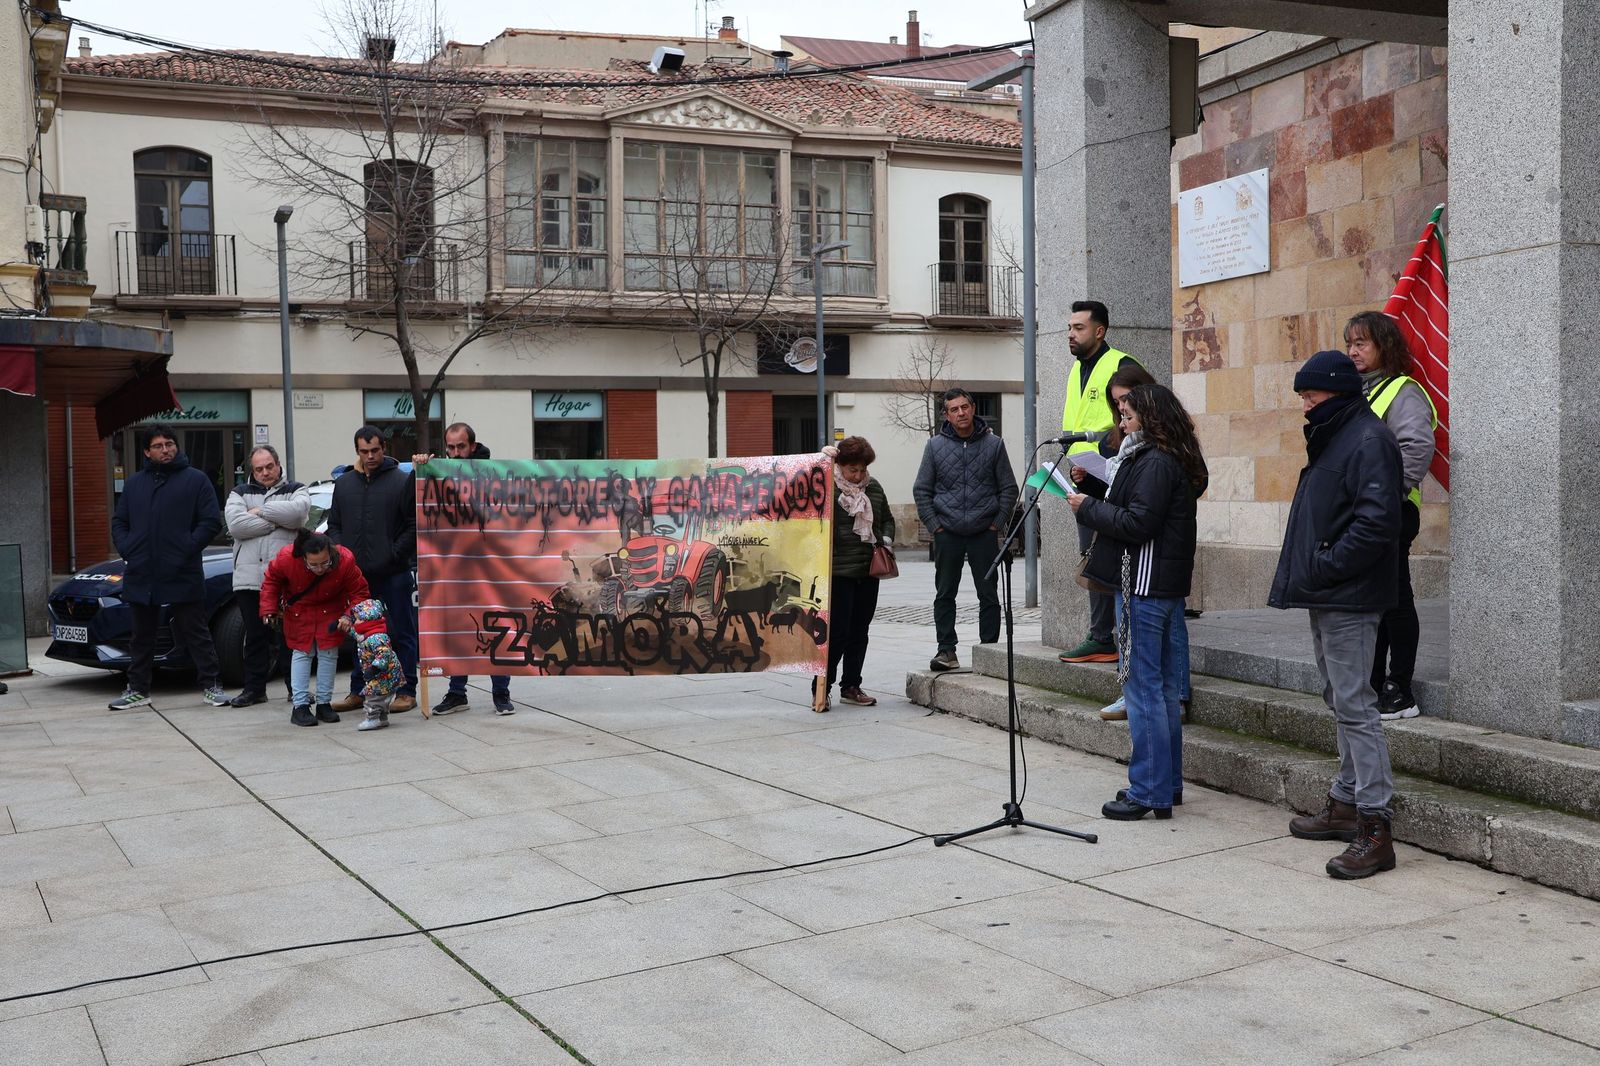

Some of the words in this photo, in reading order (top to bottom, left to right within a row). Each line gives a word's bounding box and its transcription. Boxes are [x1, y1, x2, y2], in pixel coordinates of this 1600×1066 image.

[545, 393, 592, 418] Hogar
[423, 472, 630, 525] AGRICULTORES
[669, 466, 826, 526] GANADEROS
[483, 610, 762, 670] ZAMORA
